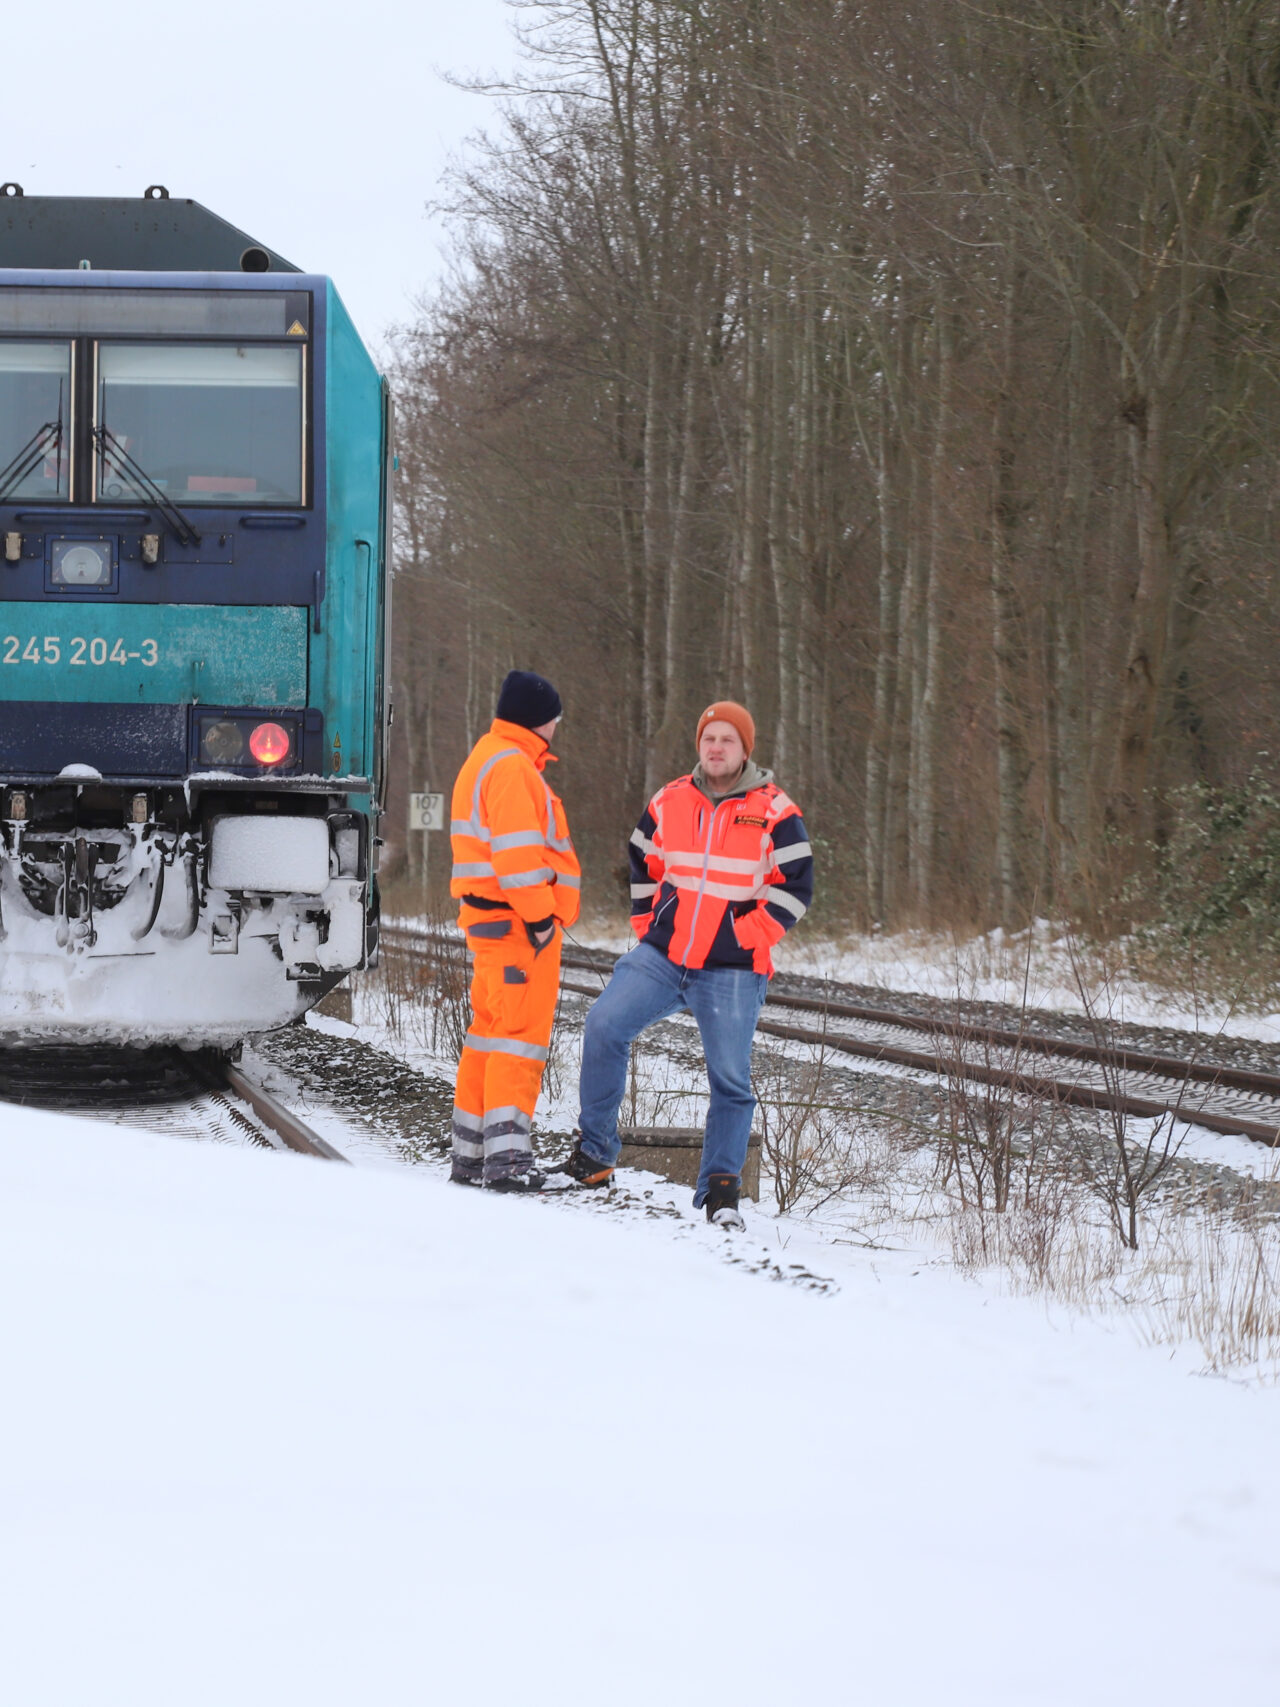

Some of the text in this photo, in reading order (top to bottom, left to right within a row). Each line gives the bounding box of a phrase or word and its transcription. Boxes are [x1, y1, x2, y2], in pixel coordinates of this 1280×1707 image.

[2, 635, 159, 667] 245 204-3
[415, 795, 439, 810] 107
[421, 811, 432, 826] 0
